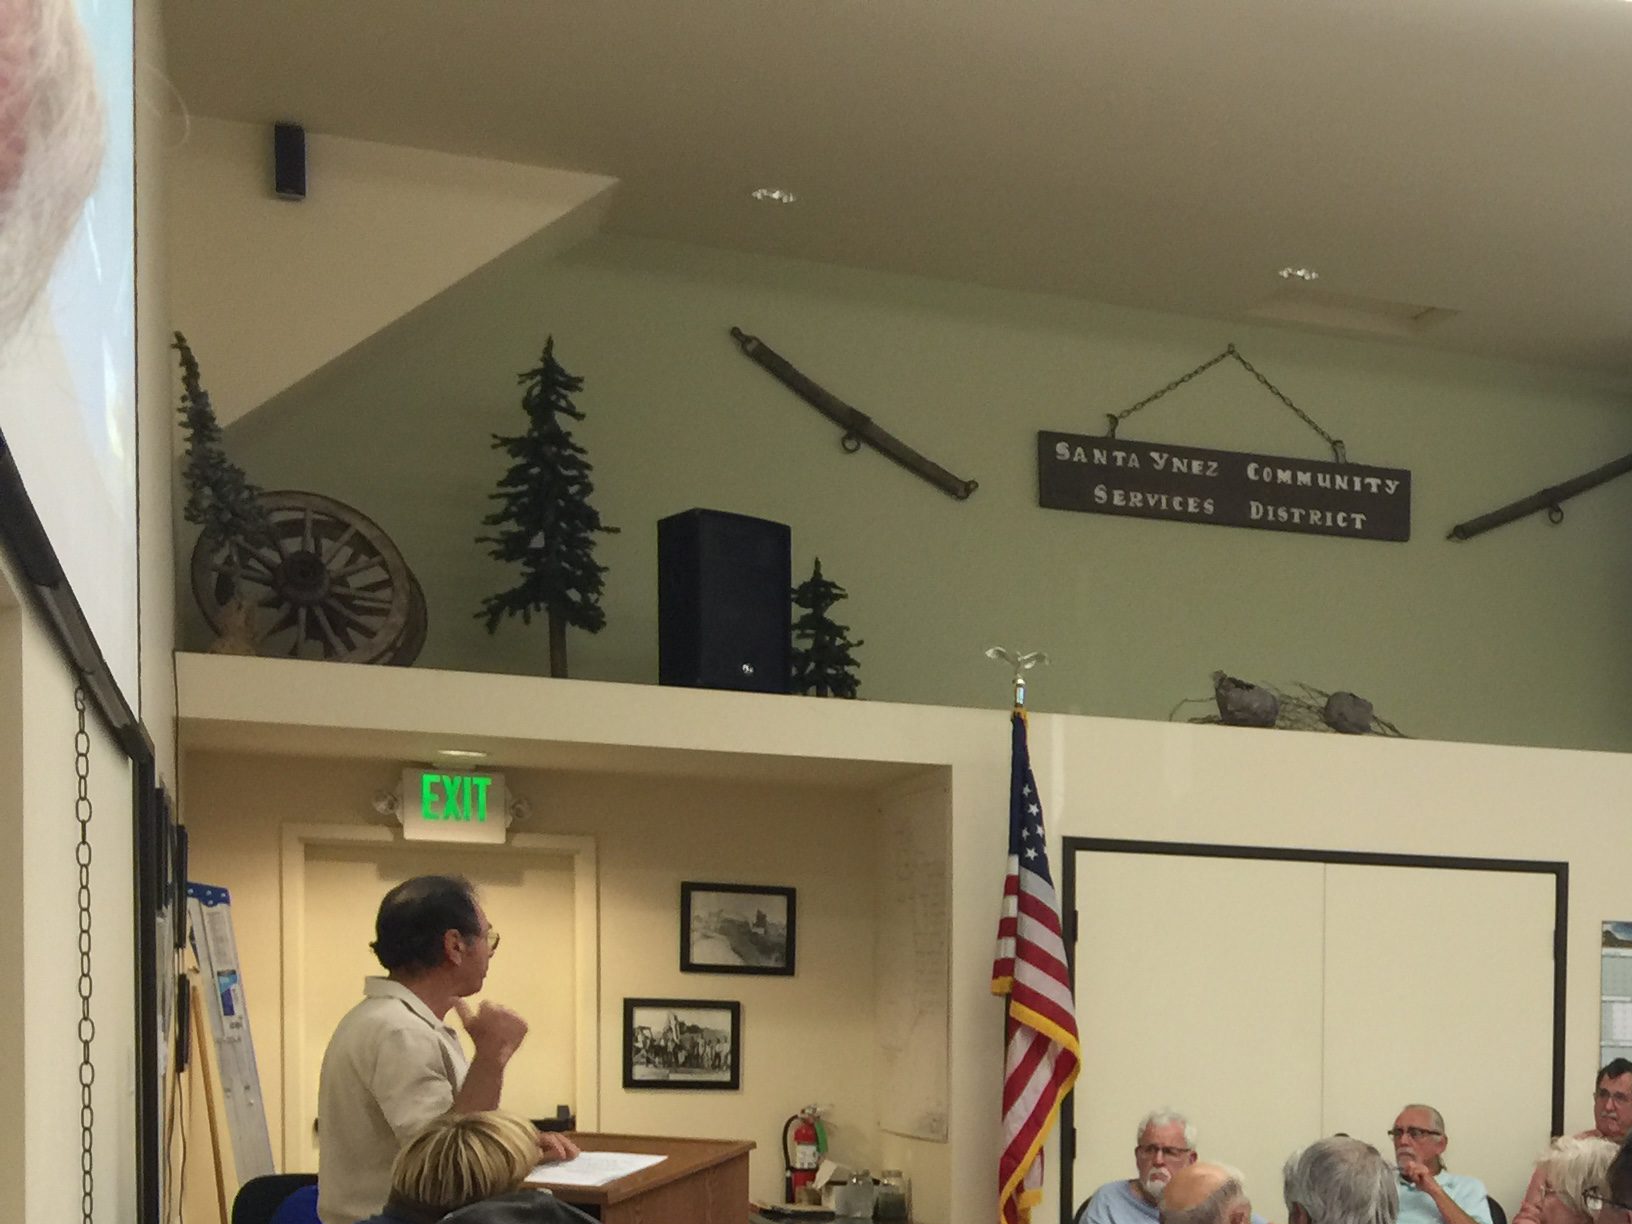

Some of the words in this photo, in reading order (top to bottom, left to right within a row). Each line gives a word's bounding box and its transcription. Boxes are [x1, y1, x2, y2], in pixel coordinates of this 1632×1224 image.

[1056, 441, 1140, 468] SANTA
[1149, 451, 1219, 477] YNEZ
[1246, 462, 1400, 494] COMMUNITY
[1094, 484, 1215, 515] SERVICES
[1249, 500, 1366, 529] DISTRICT
[422, 773, 492, 822] EXIT
